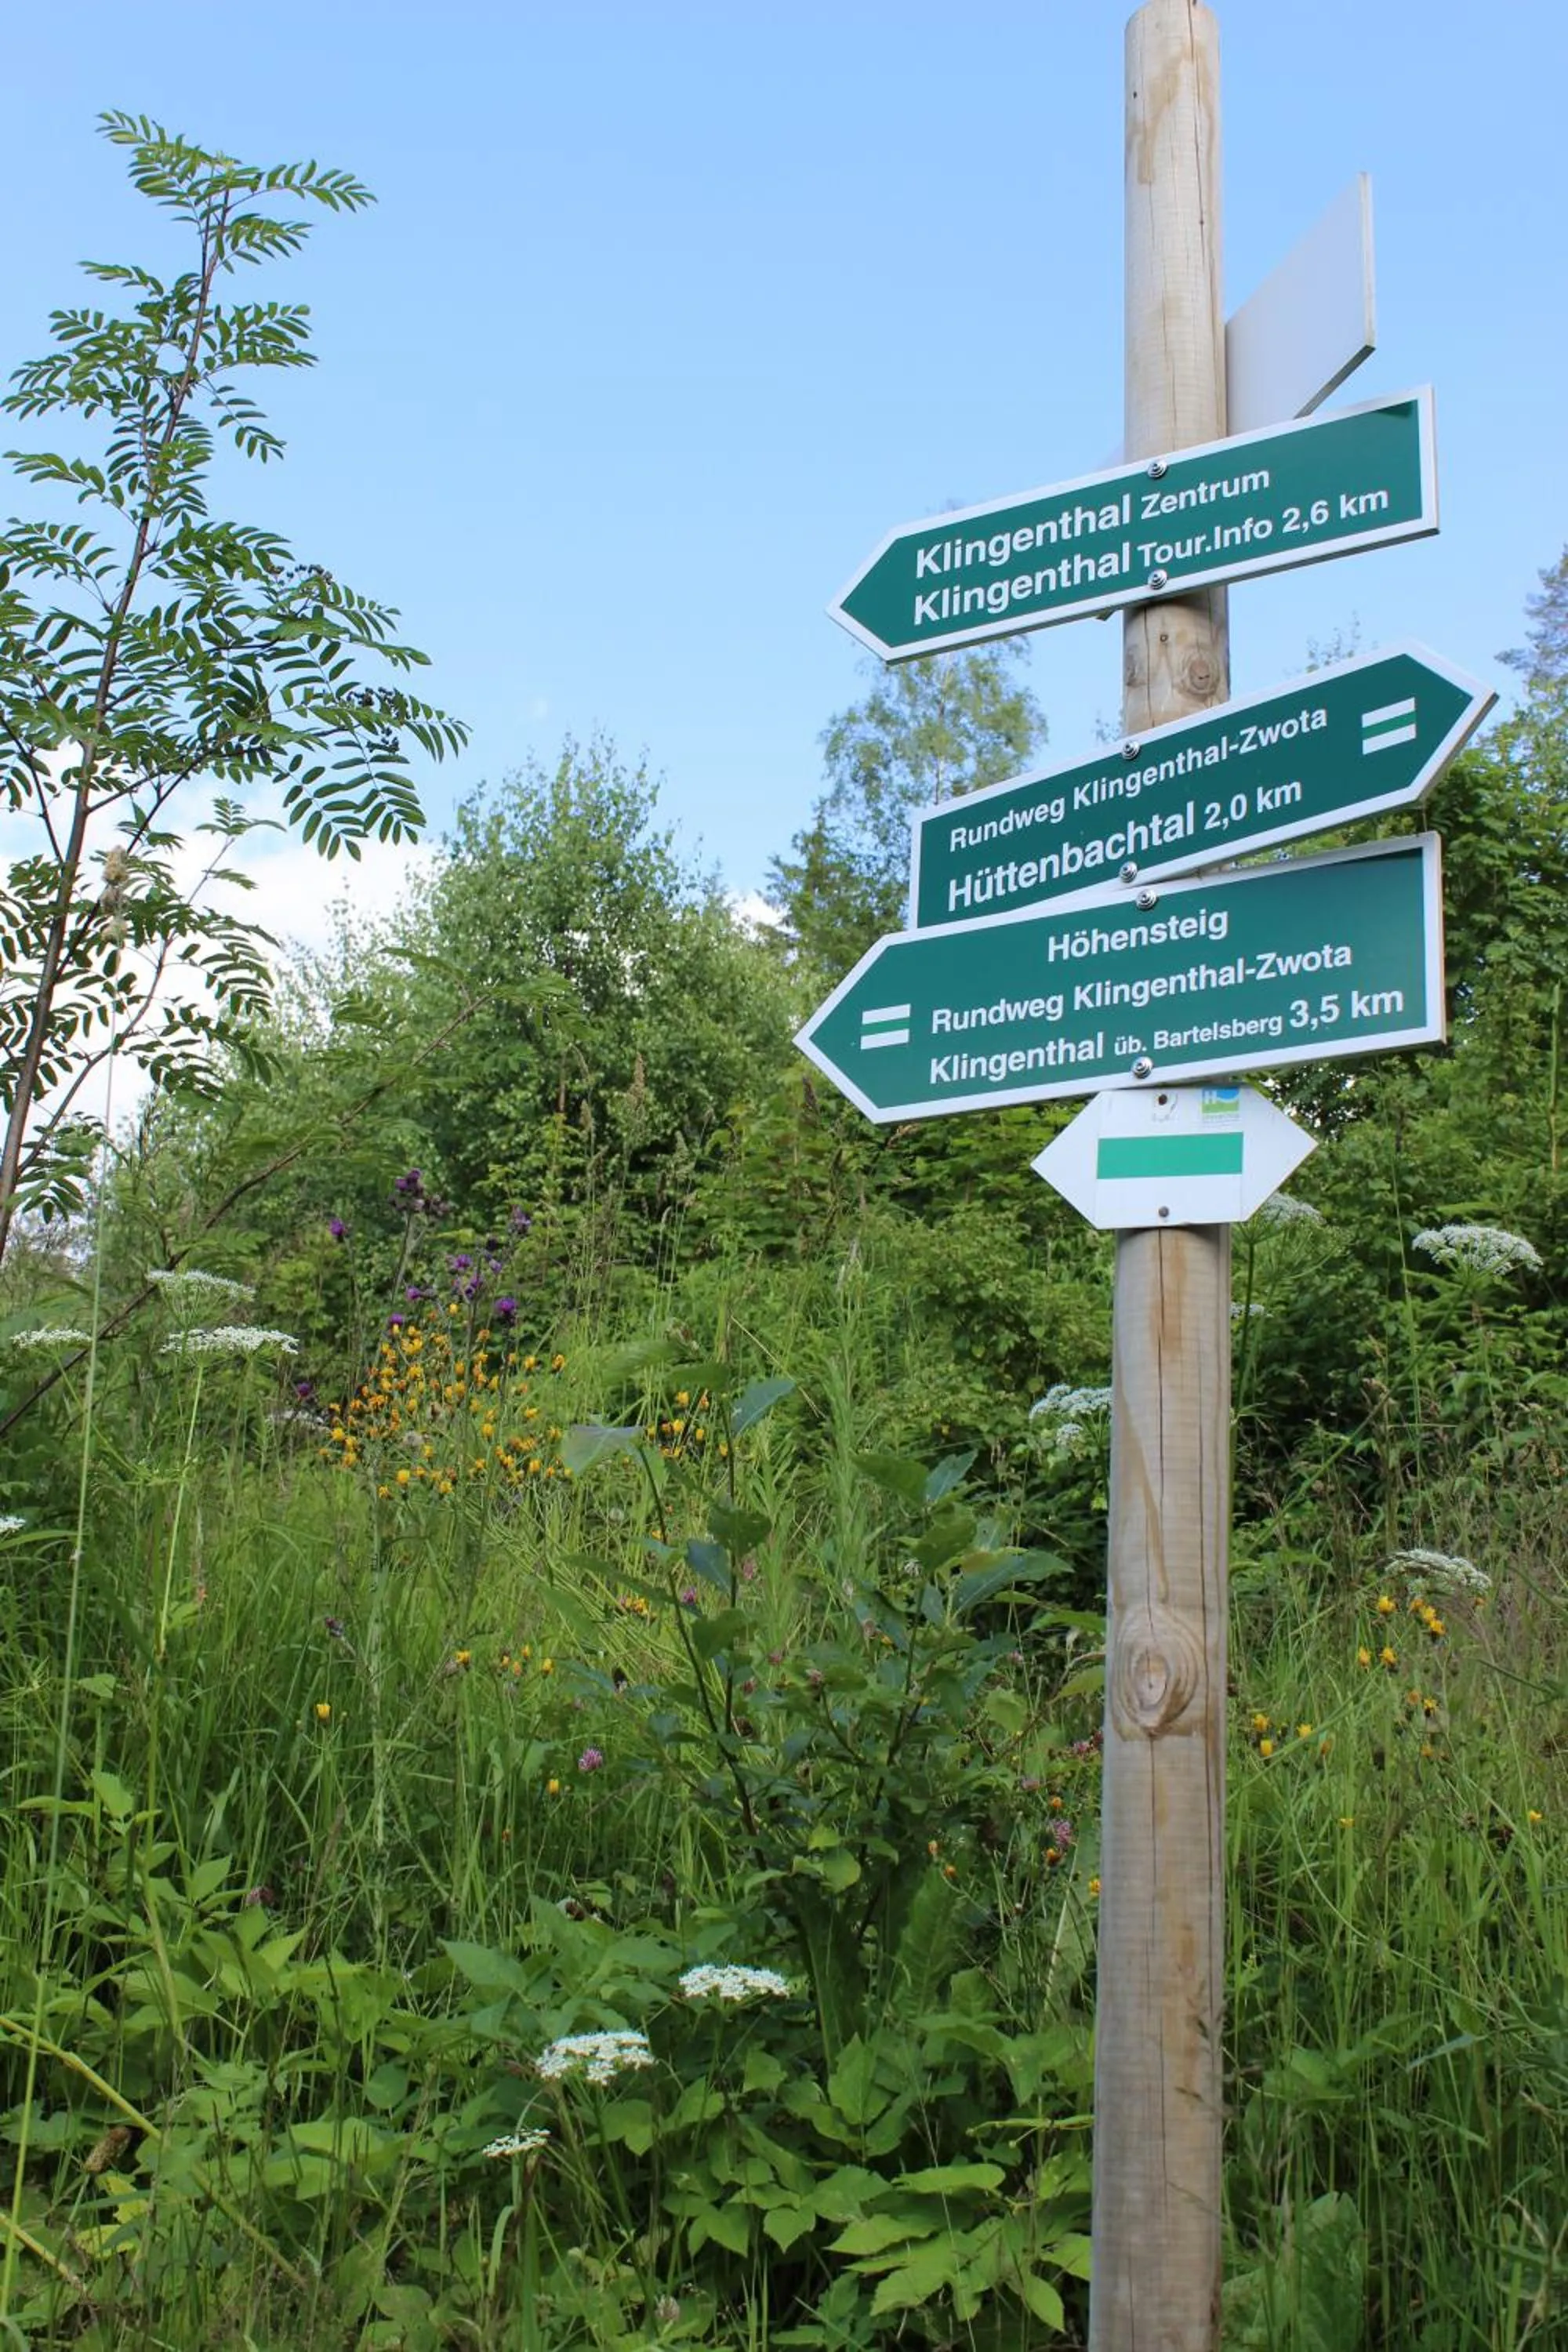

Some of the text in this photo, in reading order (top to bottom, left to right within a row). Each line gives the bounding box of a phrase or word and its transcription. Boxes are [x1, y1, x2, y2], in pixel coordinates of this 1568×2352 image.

[914, 490, 1388, 625] Klingenthal Tour.Info 2,6 km
[916, 470, 1269, 578] Klingenthal Zentrum
[950, 709, 1327, 851] Rundweg Klingenthal-Zwota
[949, 782, 1301, 912] Hüttenbachtal 2,0 km
[931, 944, 1352, 1034] Rundweg Klingenthal-Zwota
[1048, 909, 1228, 962] Höhensteig
[930, 990, 1404, 1084] Klingenthal üb. Bartelsberg 3,5 km
